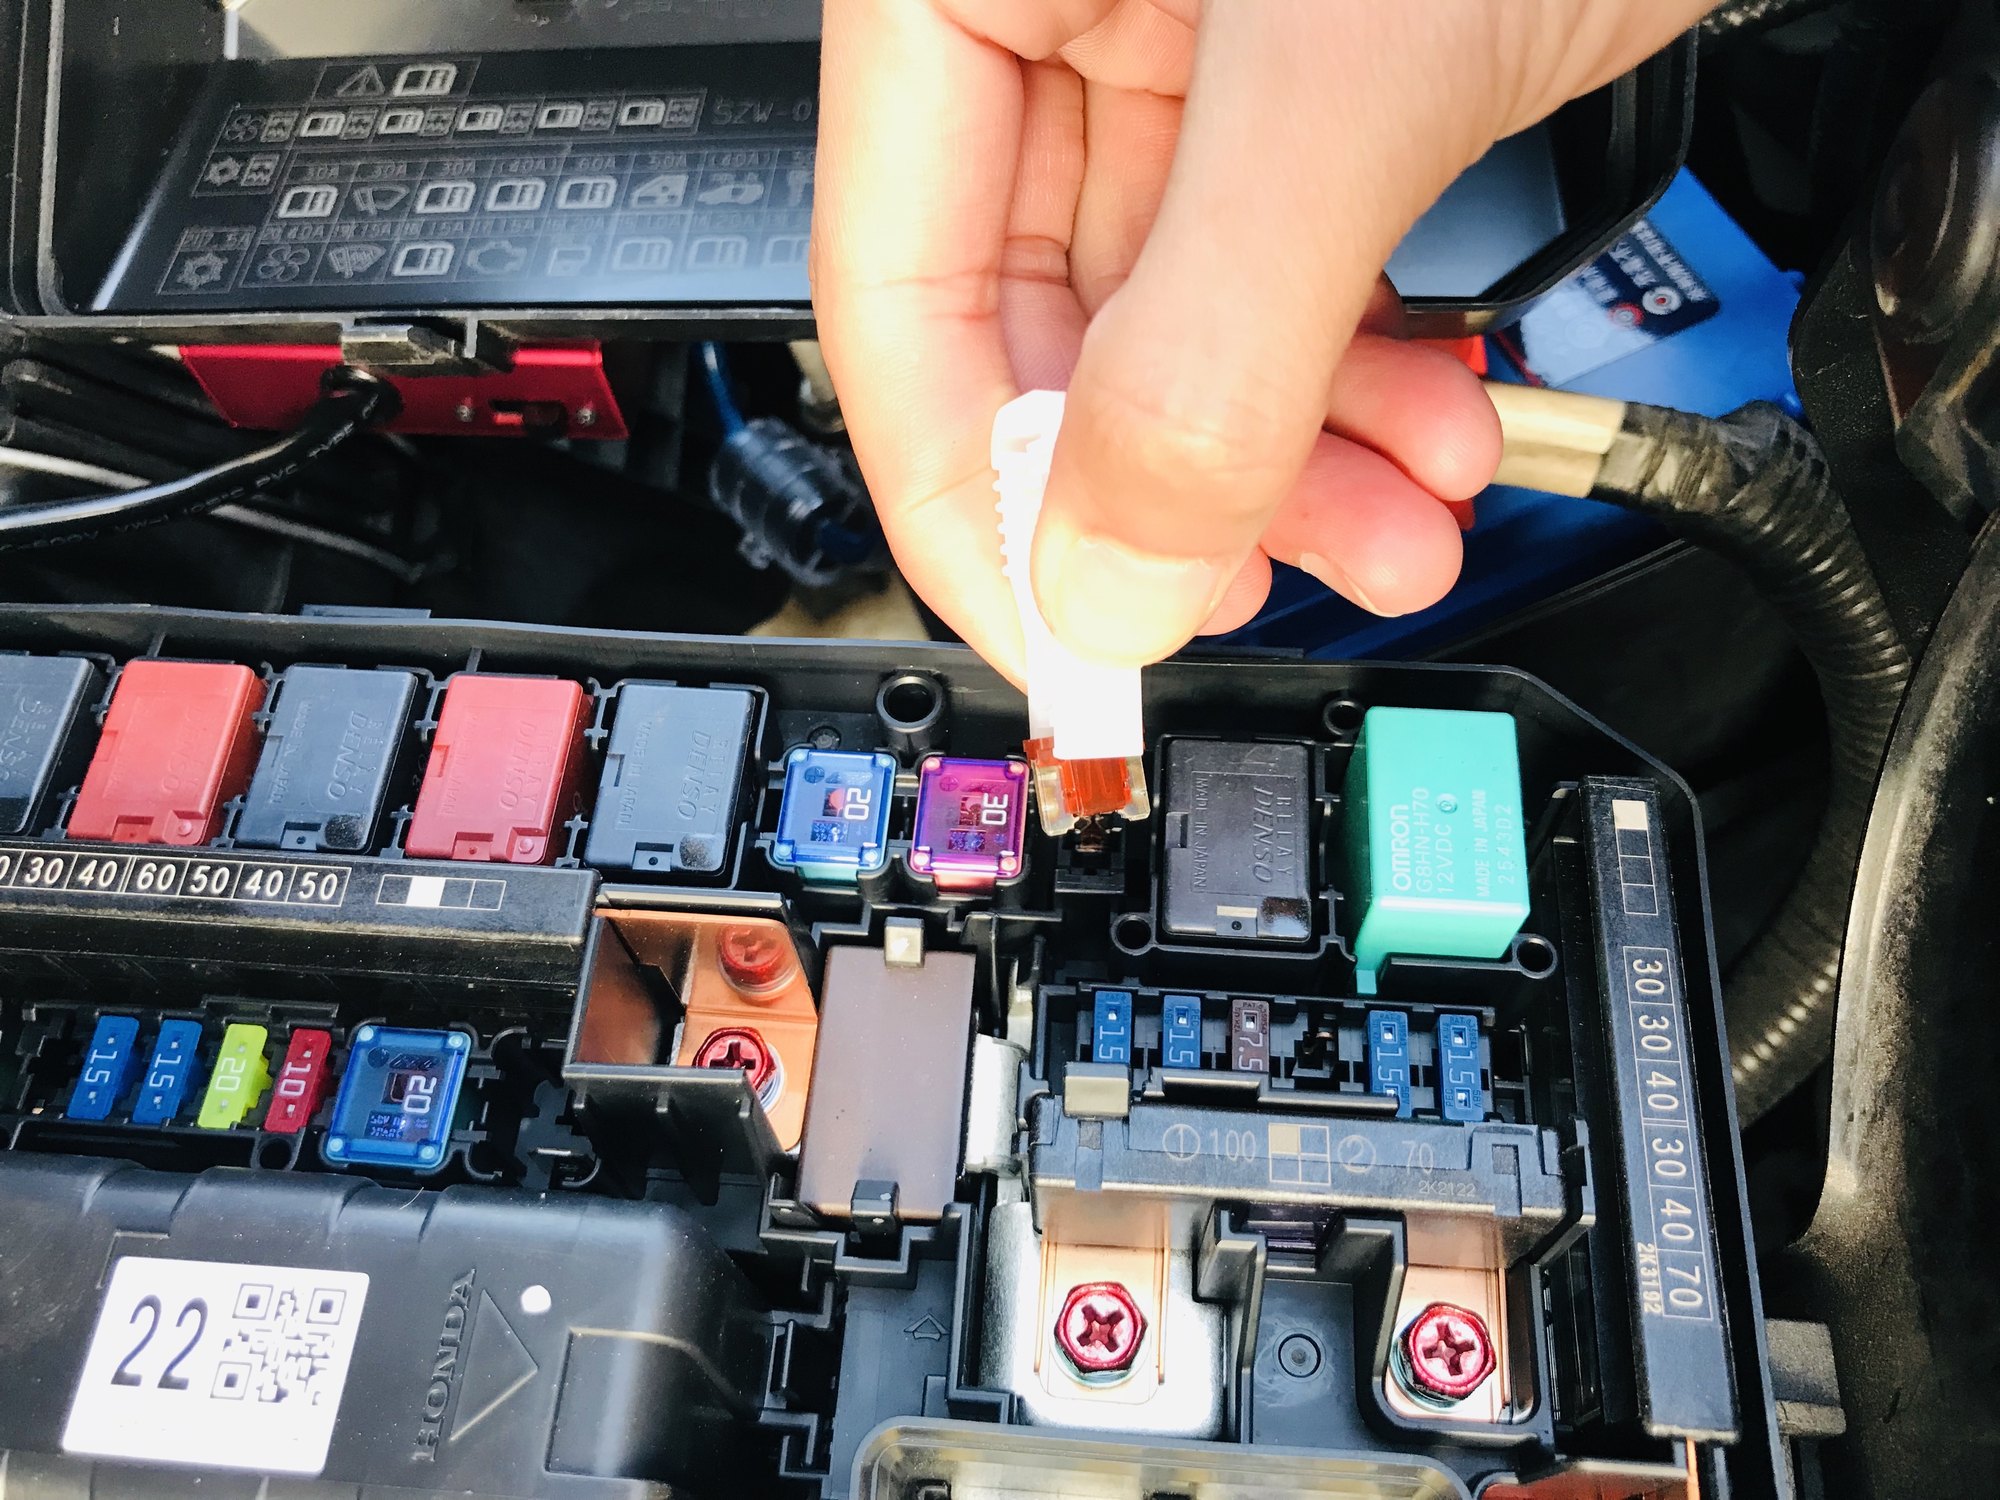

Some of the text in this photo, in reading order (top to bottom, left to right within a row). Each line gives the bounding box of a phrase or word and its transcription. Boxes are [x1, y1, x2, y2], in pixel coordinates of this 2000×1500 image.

[326, 710, 368, 801] DENSO
[677, 729, 711, 821] DENSO
[843, 787, 872, 821] 20
[981, 793, 1008, 826] 30
[1252, 786, 1274, 884] DENSO
[1471, 789, 1490, 898] MADE IN JAPAN
[1193, 841, 1209, 888] JAPAN
[1434, 823, 1455, 894] 12VDC
[24, 857, 64, 885] 30
[78, 859, 117, 886] 40
[136, 862, 177, 892] 60
[189, 866, 231, 895] 50
[245, 869, 284, 898] 40
[299, 871, 339, 901] 50
[1098, 1025, 1125, 1061] 15
[1168, 1028, 1195, 1063] 15
[1238, 1032, 1264, 1071] 7.5
[84, 1049, 118, 1085] 15
[149, 1054, 182, 1089] 15
[215, 1056, 247, 1093] 20
[279, 1062, 307, 1097] 10
[1376, 1046, 1404, 1082] 15
[1447, 1049, 1475, 1084] 15
[403, 1074, 437, 1115] 20
[1210, 1131, 1257, 1163] 100
[1634, 959, 1703, 1309] 30 30 40 30 40 70
[1402, 1140, 1434, 1174] 70
[110, 1294, 209, 1390] 22
[411, 1268, 477, 1462] HONDA
